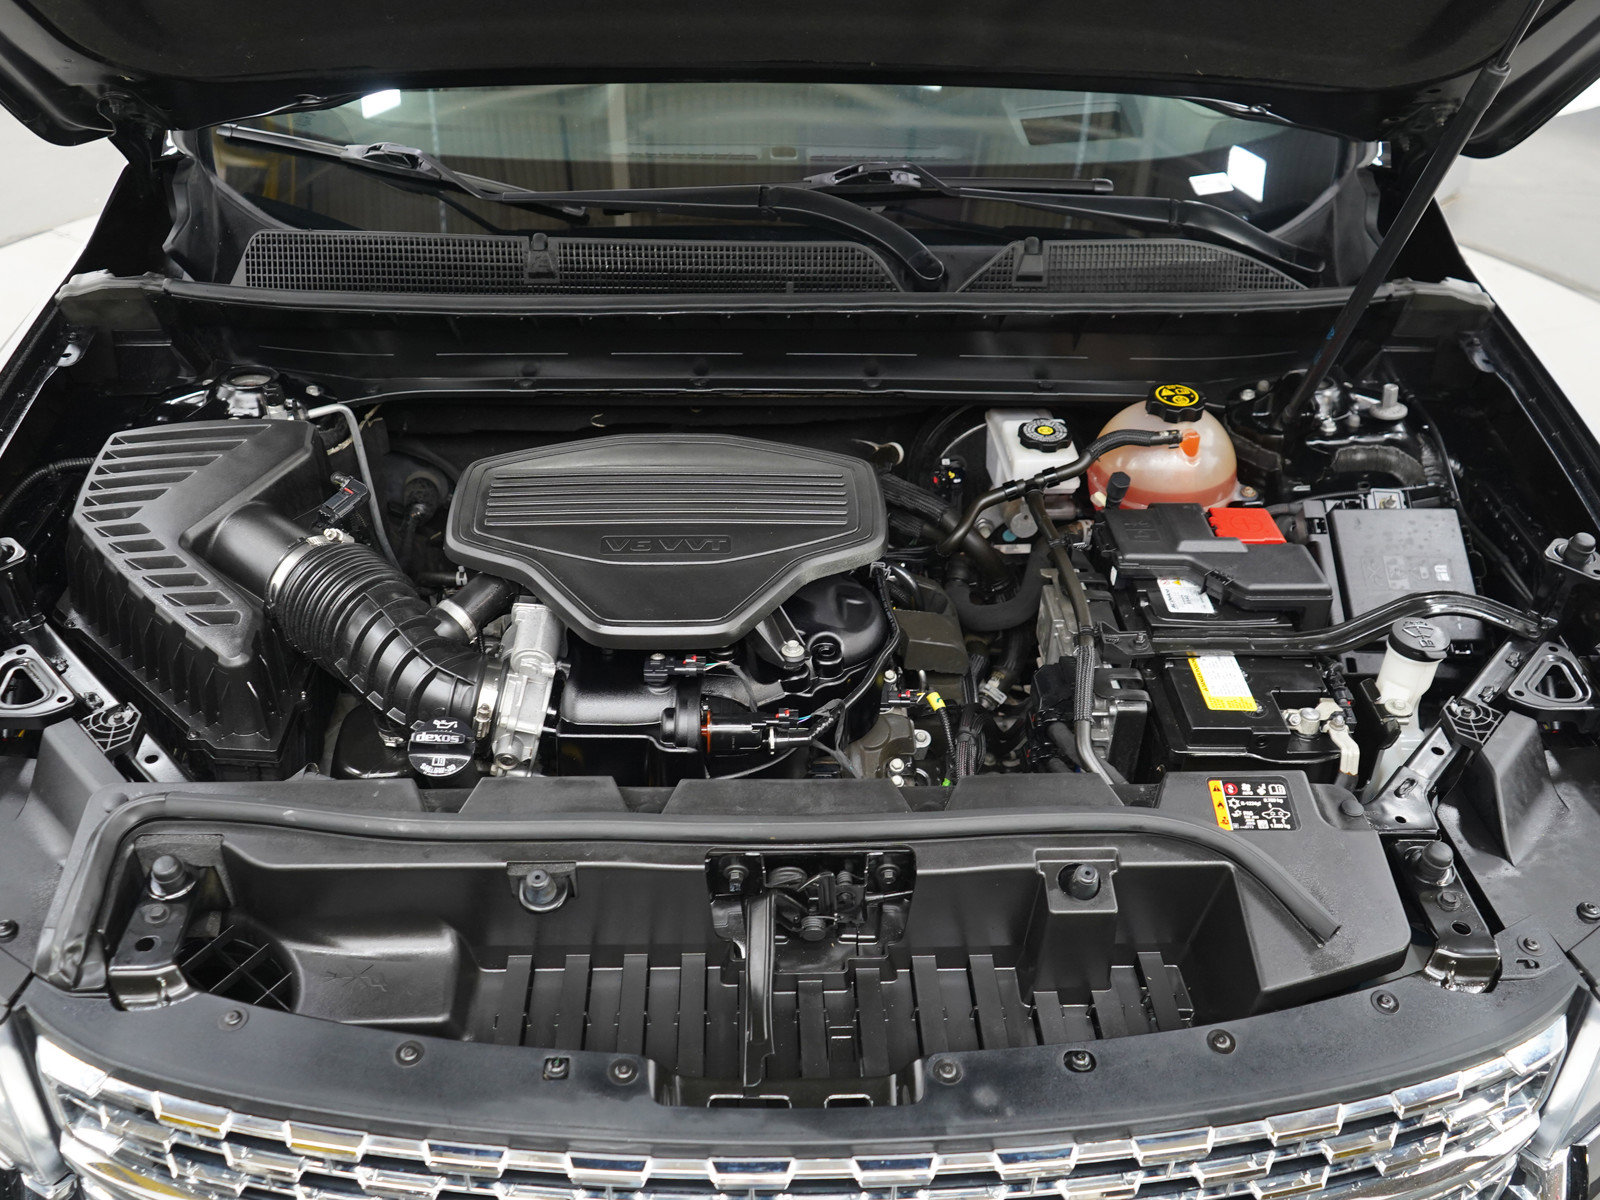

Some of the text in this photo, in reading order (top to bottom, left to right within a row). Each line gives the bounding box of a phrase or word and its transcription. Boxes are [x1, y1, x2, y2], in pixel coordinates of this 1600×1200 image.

[605, 539, 727, 552] V6 VVT
[415, 732, 460, 742] dexos
